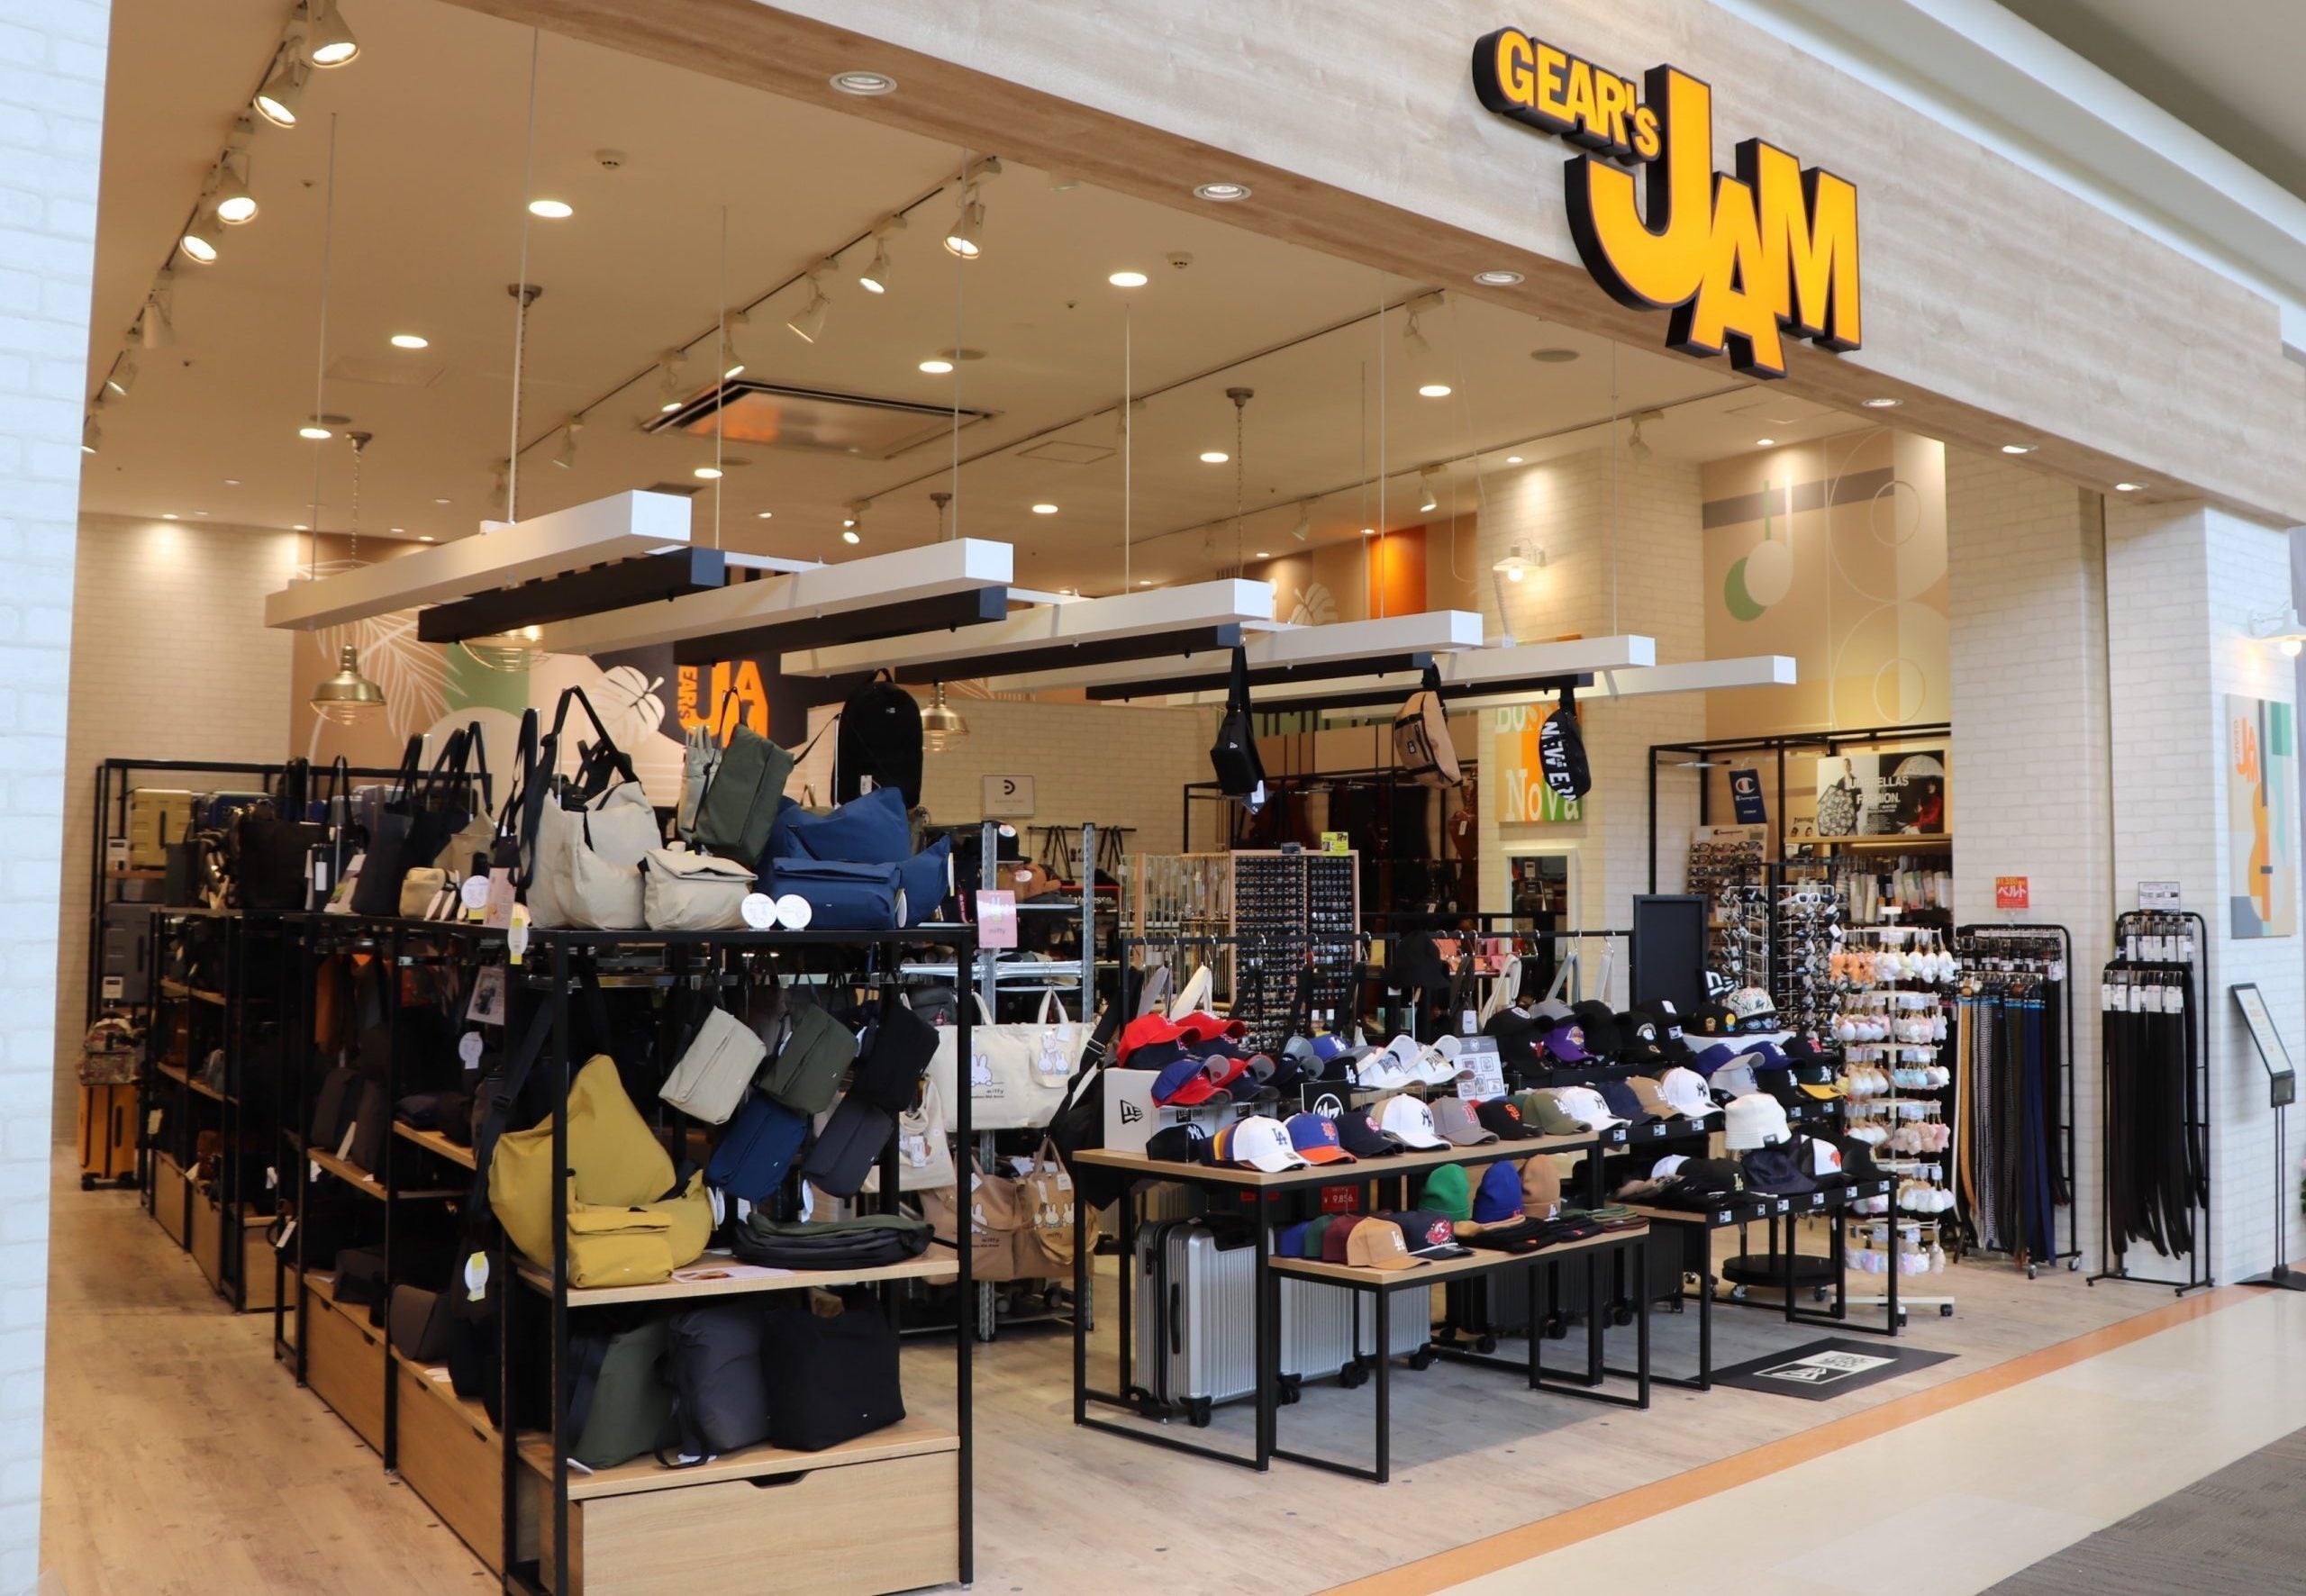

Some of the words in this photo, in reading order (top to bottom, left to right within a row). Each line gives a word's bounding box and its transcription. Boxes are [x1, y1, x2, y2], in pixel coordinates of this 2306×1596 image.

[1585, 67, 1862, 375] JAM
[1850, 775, 1910, 790] UMBRELLAS
[1735, 794, 1760, 803] Champion
[1997, 884, 2027, 899] ベルト
[1271, 1128, 1288, 1146] LA
